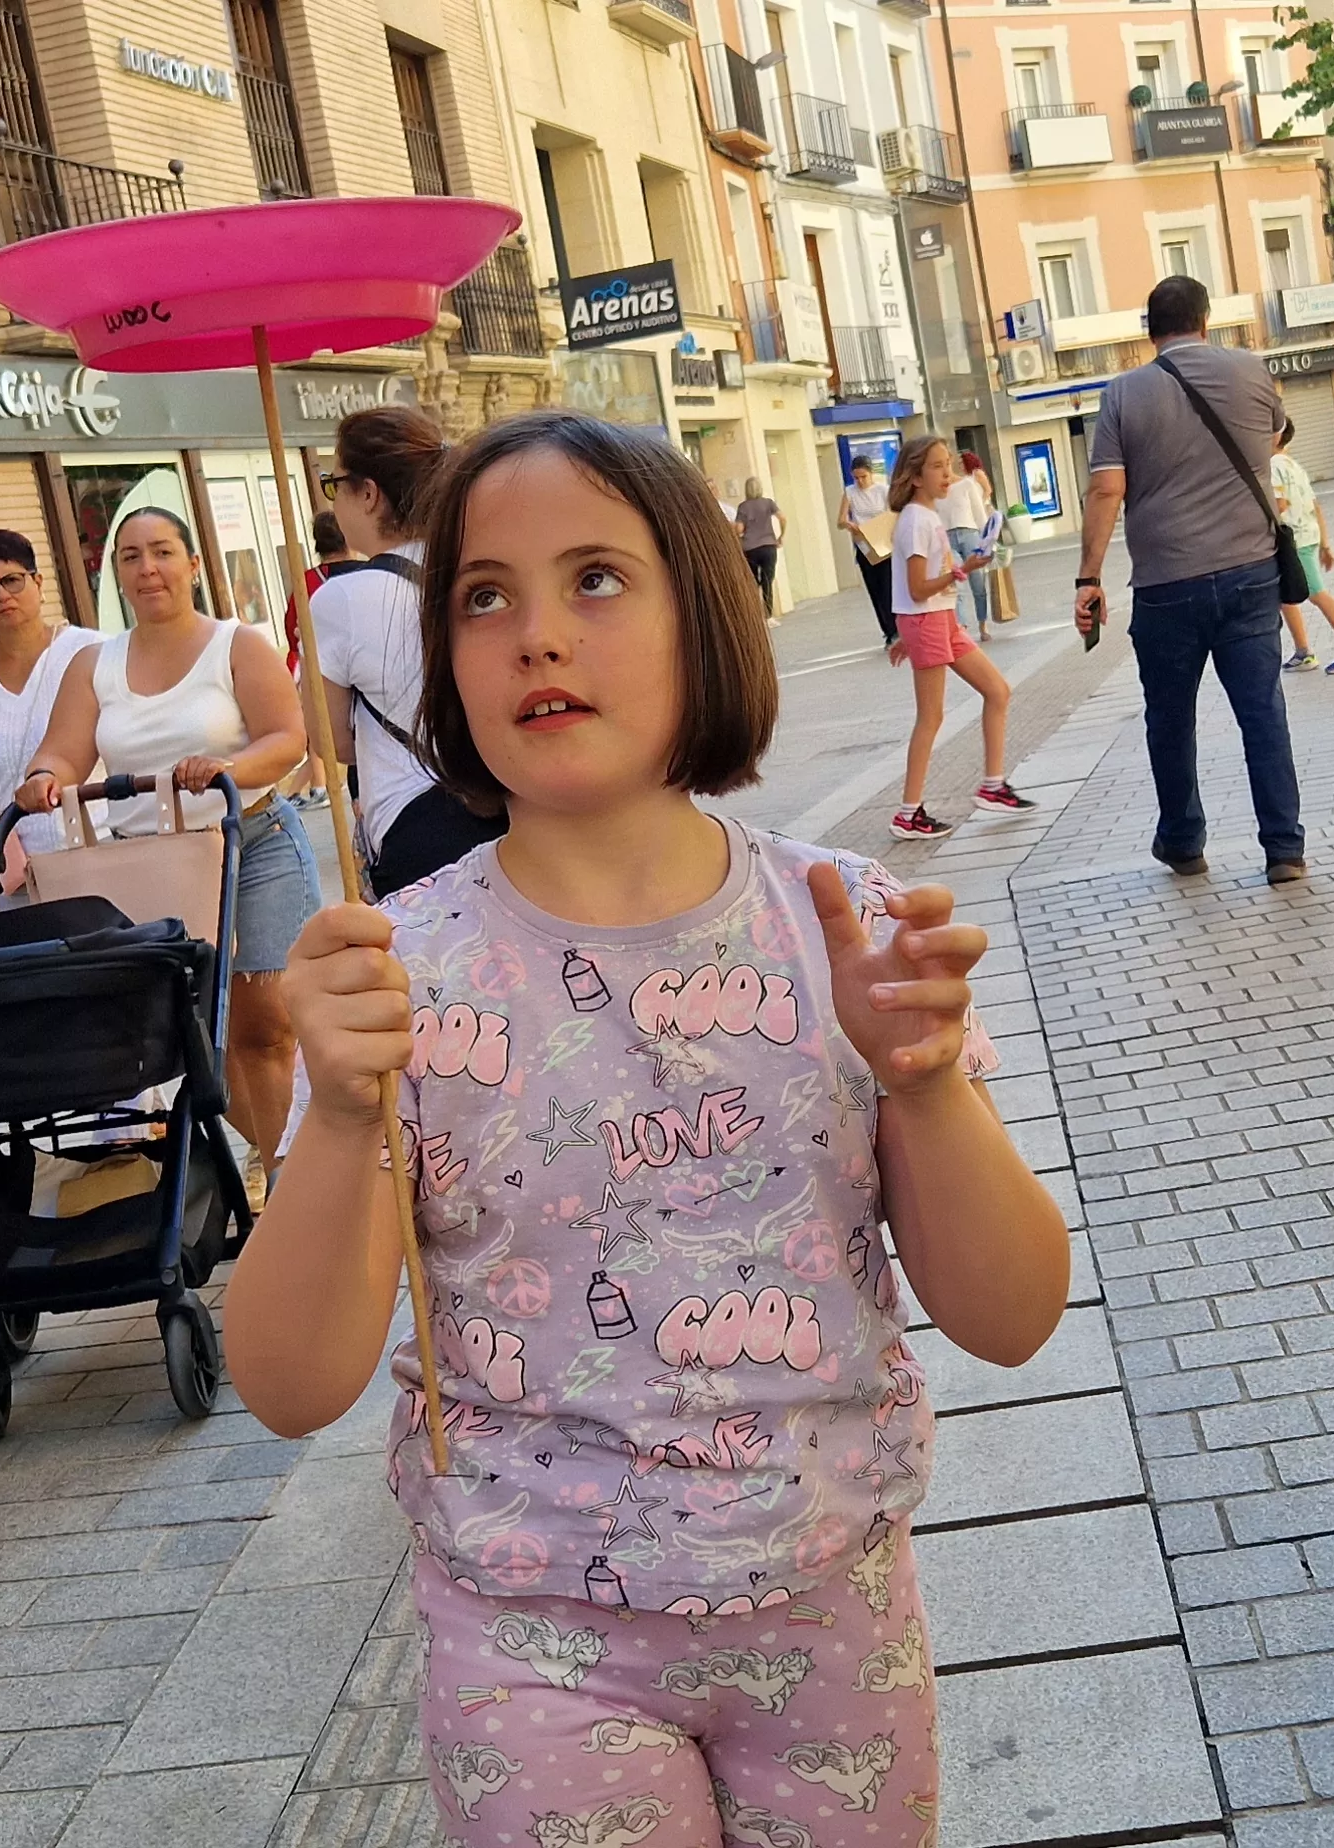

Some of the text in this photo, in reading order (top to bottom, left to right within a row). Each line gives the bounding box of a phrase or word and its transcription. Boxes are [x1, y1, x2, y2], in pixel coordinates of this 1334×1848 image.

[570, 287, 674, 328] Arenas
[572, 327, 603, 341] CENTRO
[634, 321, 641, 330] Y
[641, 313, 678, 328] AUDITIVO
[629, 963, 799, 1046] COOL
[598, 1087, 765, 1184] LOVE
[654, 1286, 822, 1371] COOL
